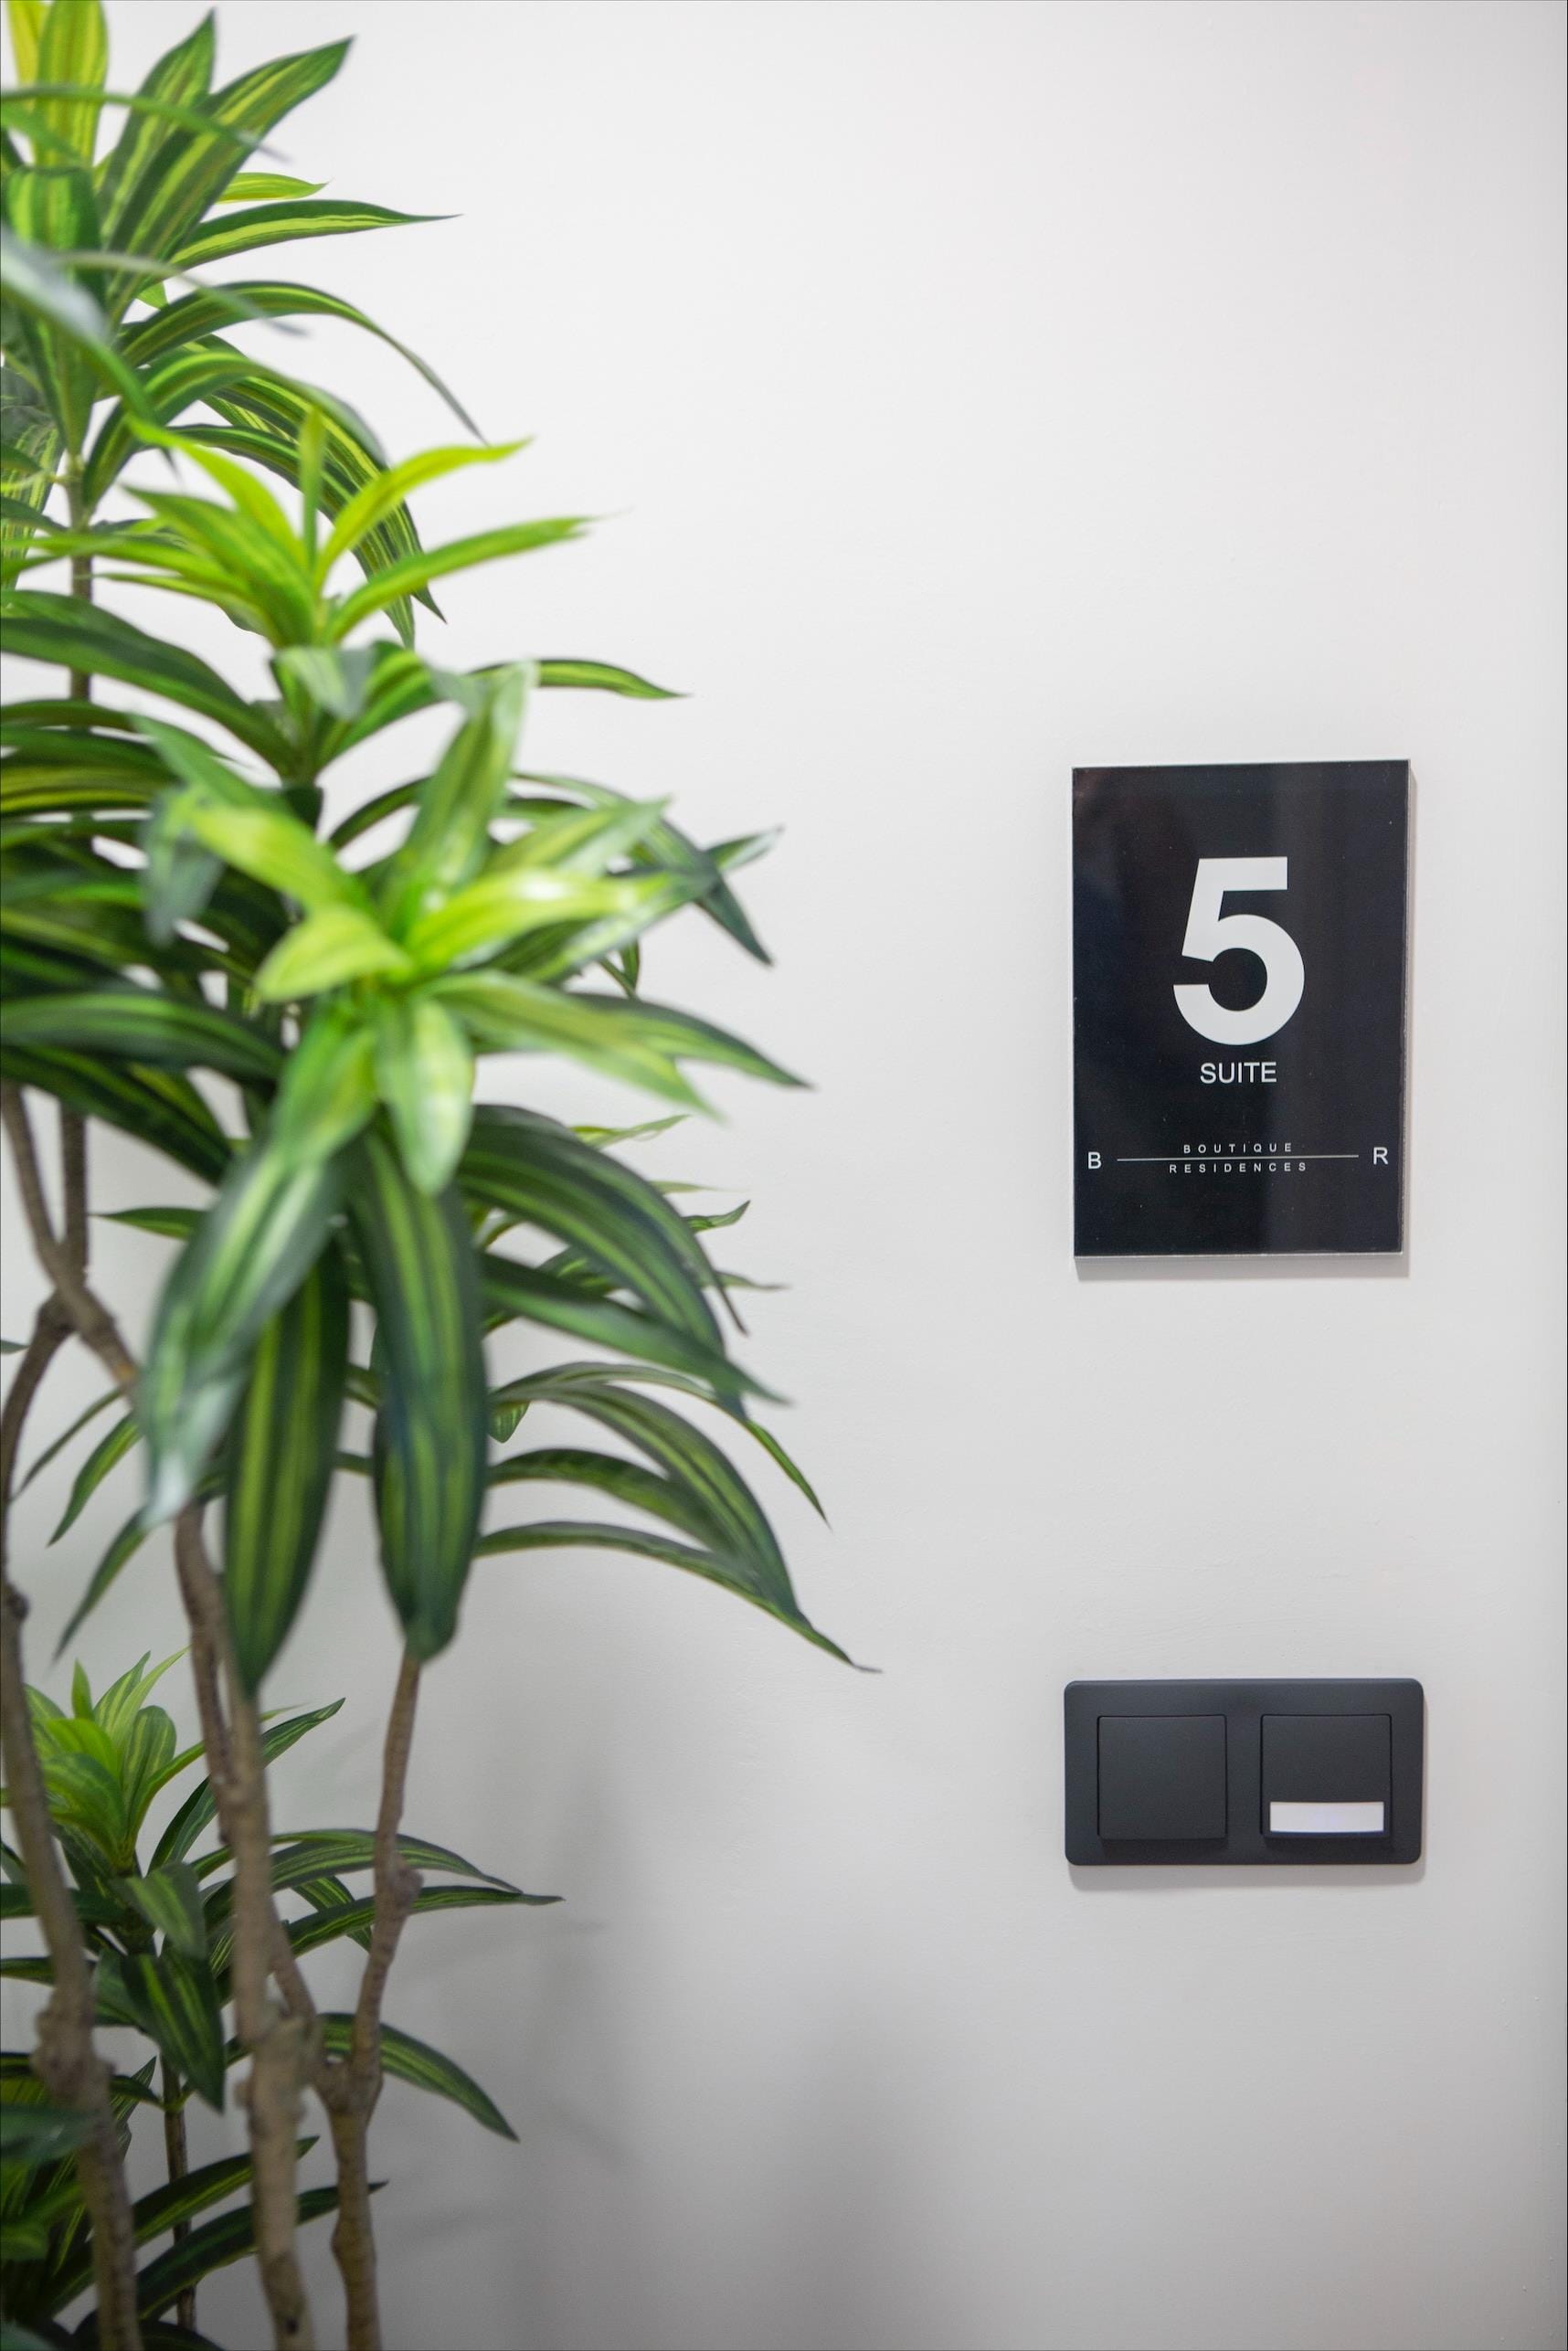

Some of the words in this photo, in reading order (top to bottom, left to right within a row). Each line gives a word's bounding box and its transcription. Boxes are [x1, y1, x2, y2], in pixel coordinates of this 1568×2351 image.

[1172, 855, 1305, 1046] 5
[1200, 1061, 1277, 1085] SUITE
[1183, 1142, 1292, 1154] BOUTIQUE
[1372, 1146, 1389, 1165] R
[1087, 1151, 1102, 1170] B
[1169, 1161, 1306, 1173] RESIDENCES
